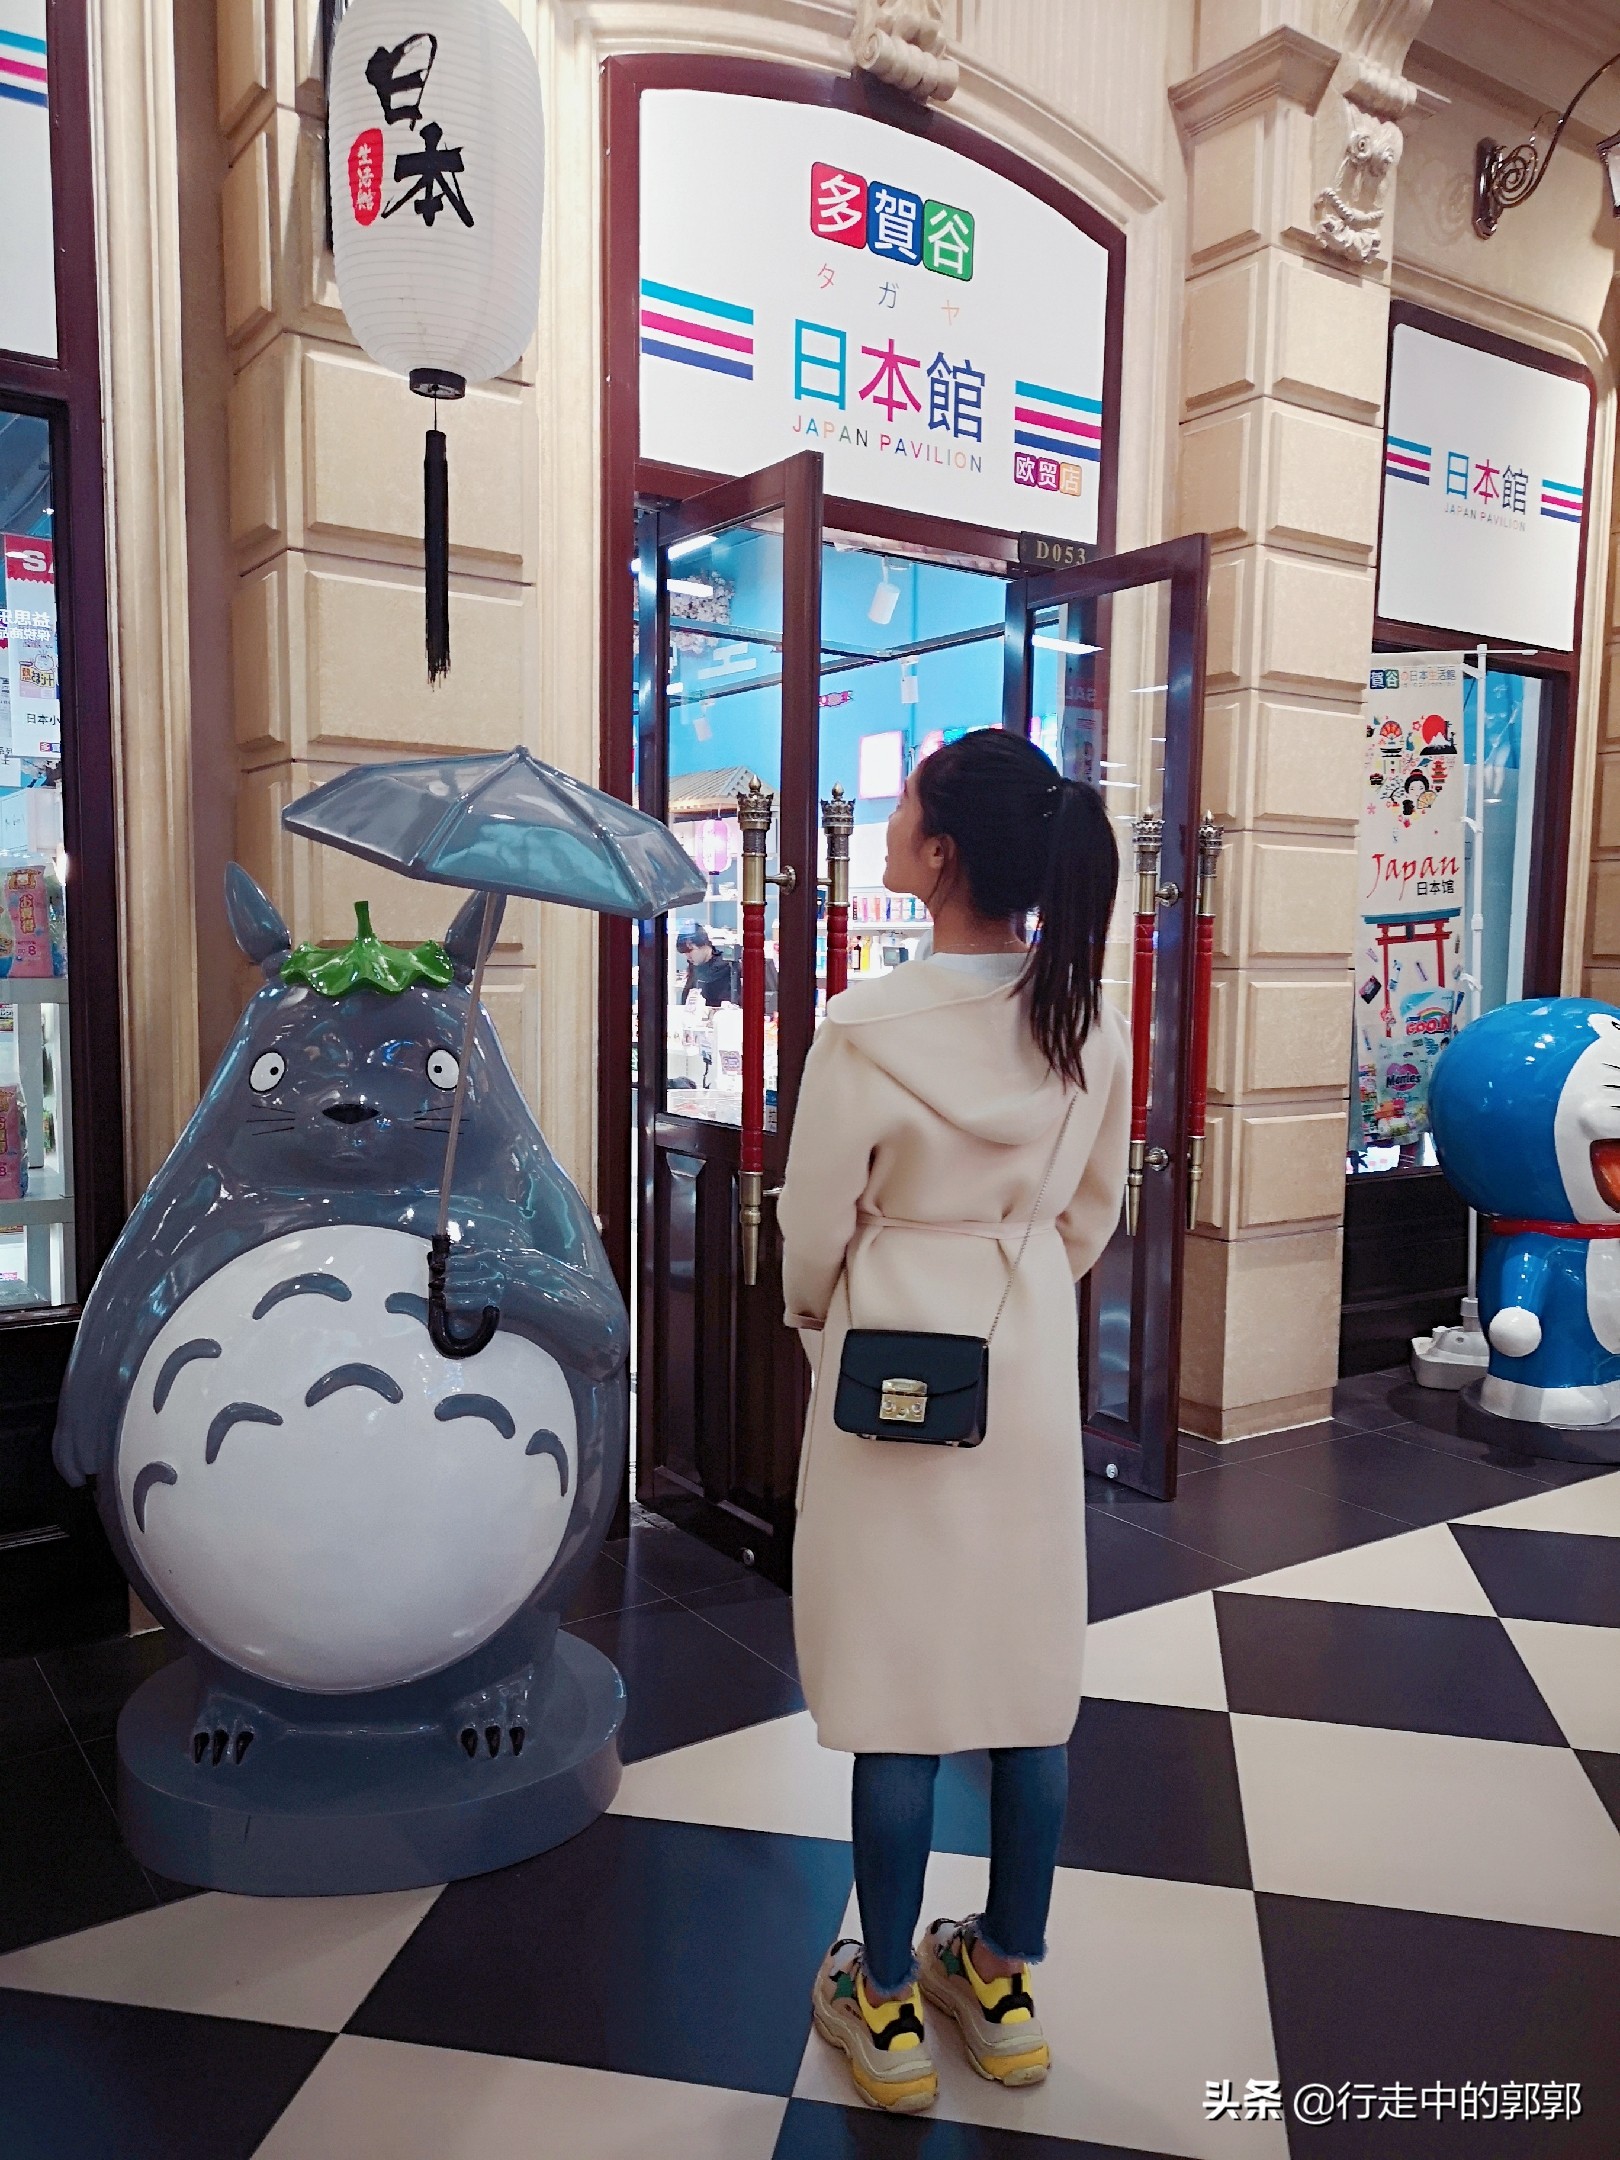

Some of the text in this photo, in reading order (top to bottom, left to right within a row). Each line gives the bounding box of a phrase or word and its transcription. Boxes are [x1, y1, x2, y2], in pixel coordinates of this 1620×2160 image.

[365, 33, 474, 226] 日本
[817, 174, 970, 275] 多賀谷
[794, 318, 986, 443] 日本館
[793, 415, 982, 473] JAPAN PAVILION
[1016, 457, 1080, 493] 欧贸店
[1446, 451, 1529, 515] 日本館
[1444, 503, 1526, 532] JAPAN PAVILION
[1036, 540, 1086, 565] D053
[1367, 853, 1460, 901] Japan
[1417, 879, 1454, 896] 日本馆
